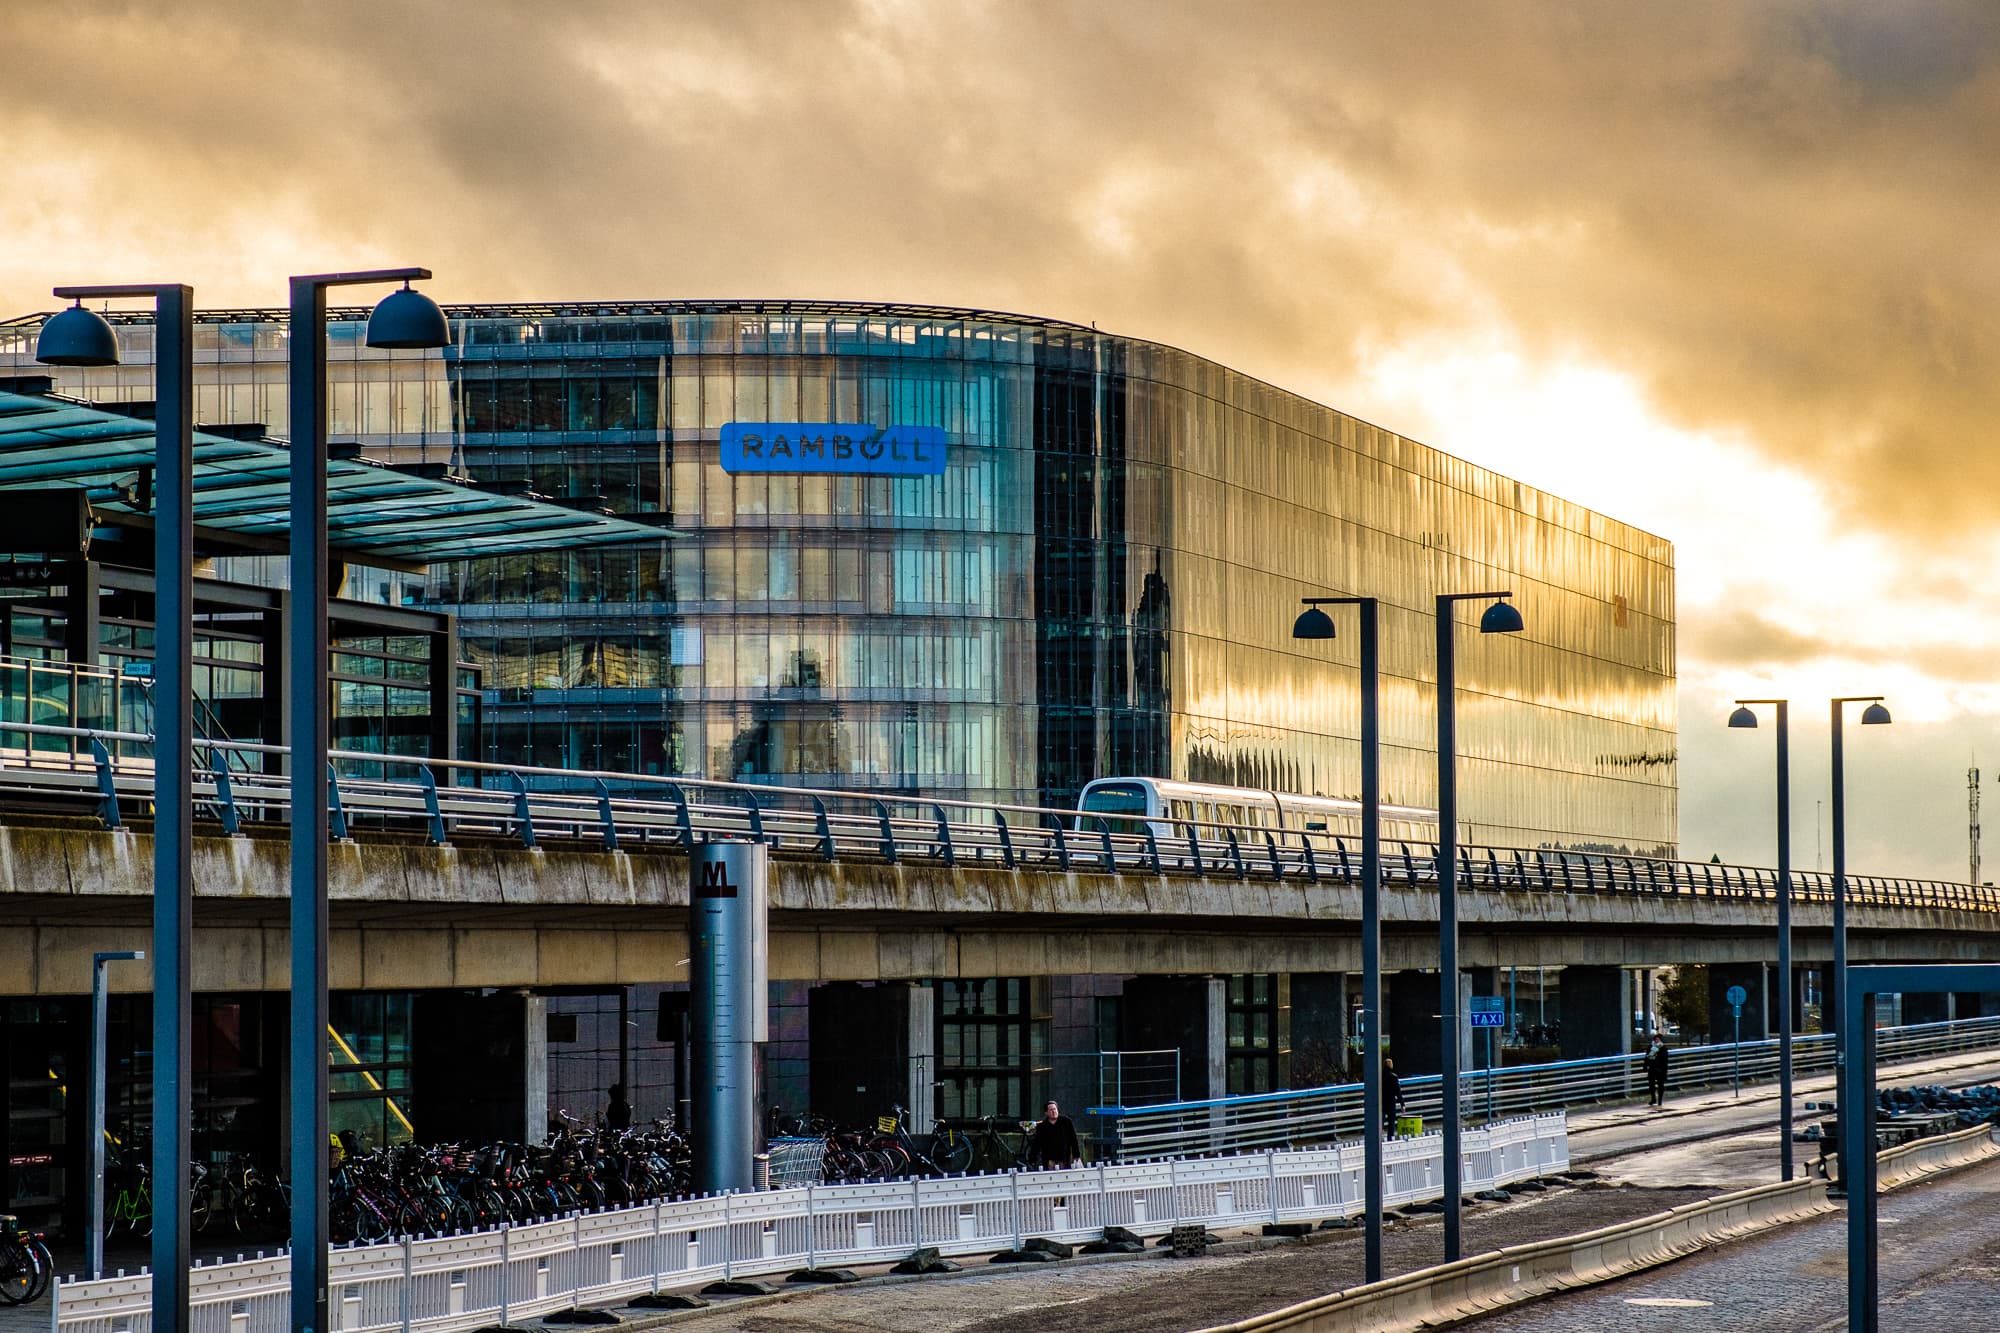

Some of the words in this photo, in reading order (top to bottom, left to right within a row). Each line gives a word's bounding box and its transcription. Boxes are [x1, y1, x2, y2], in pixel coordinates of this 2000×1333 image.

[742, 433, 931, 462] RAMBØLL
[702, 861, 728, 887] M
[1472, 1014, 1502, 1025] TAXI
